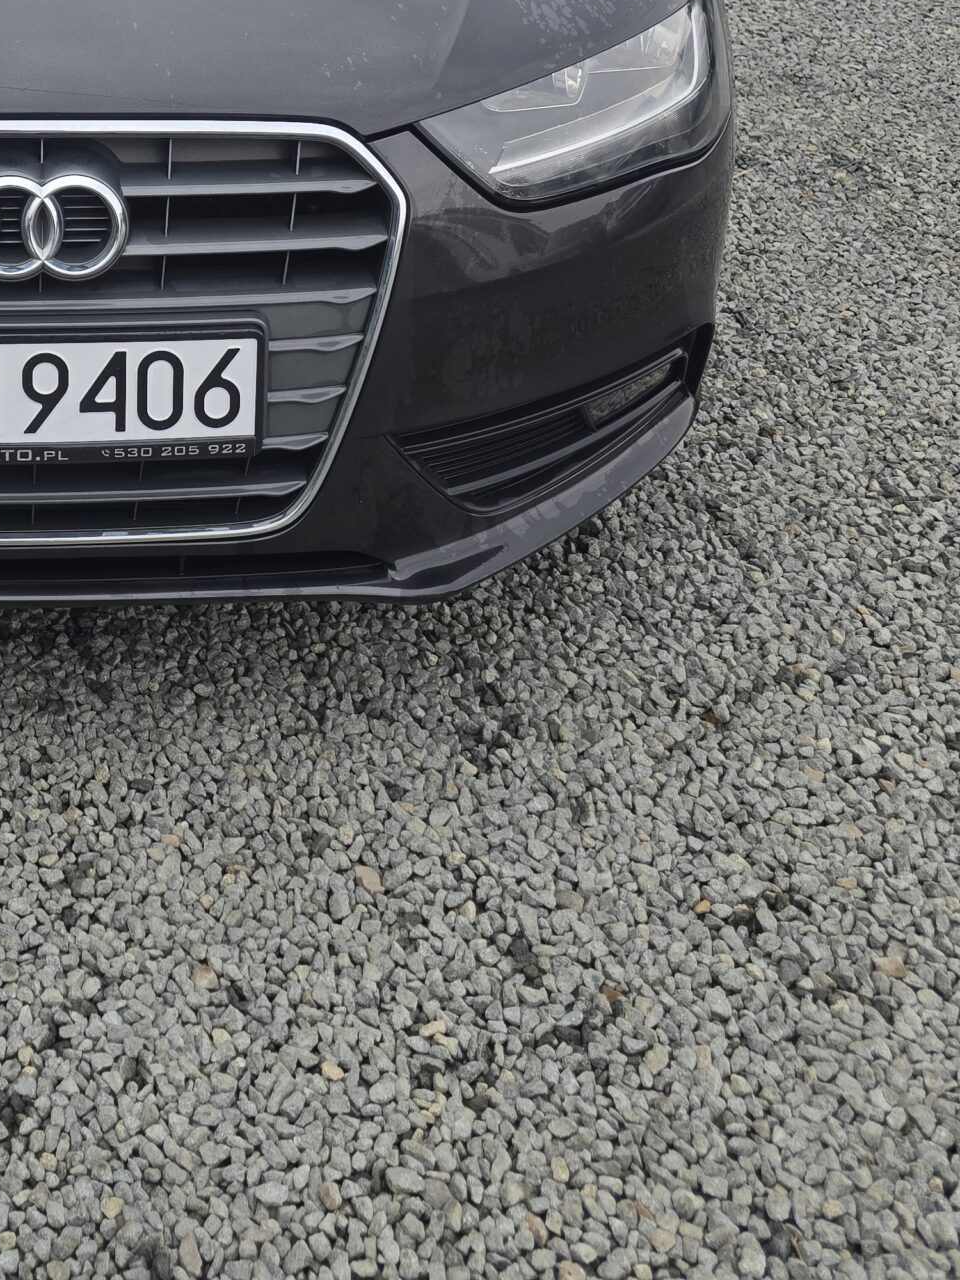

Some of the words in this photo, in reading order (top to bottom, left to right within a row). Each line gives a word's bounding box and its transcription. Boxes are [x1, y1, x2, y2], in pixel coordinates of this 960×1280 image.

[114, 447, 153, 458] 530
[160, 445, 200, 456] 205
[208, 443, 246, 454] 922
